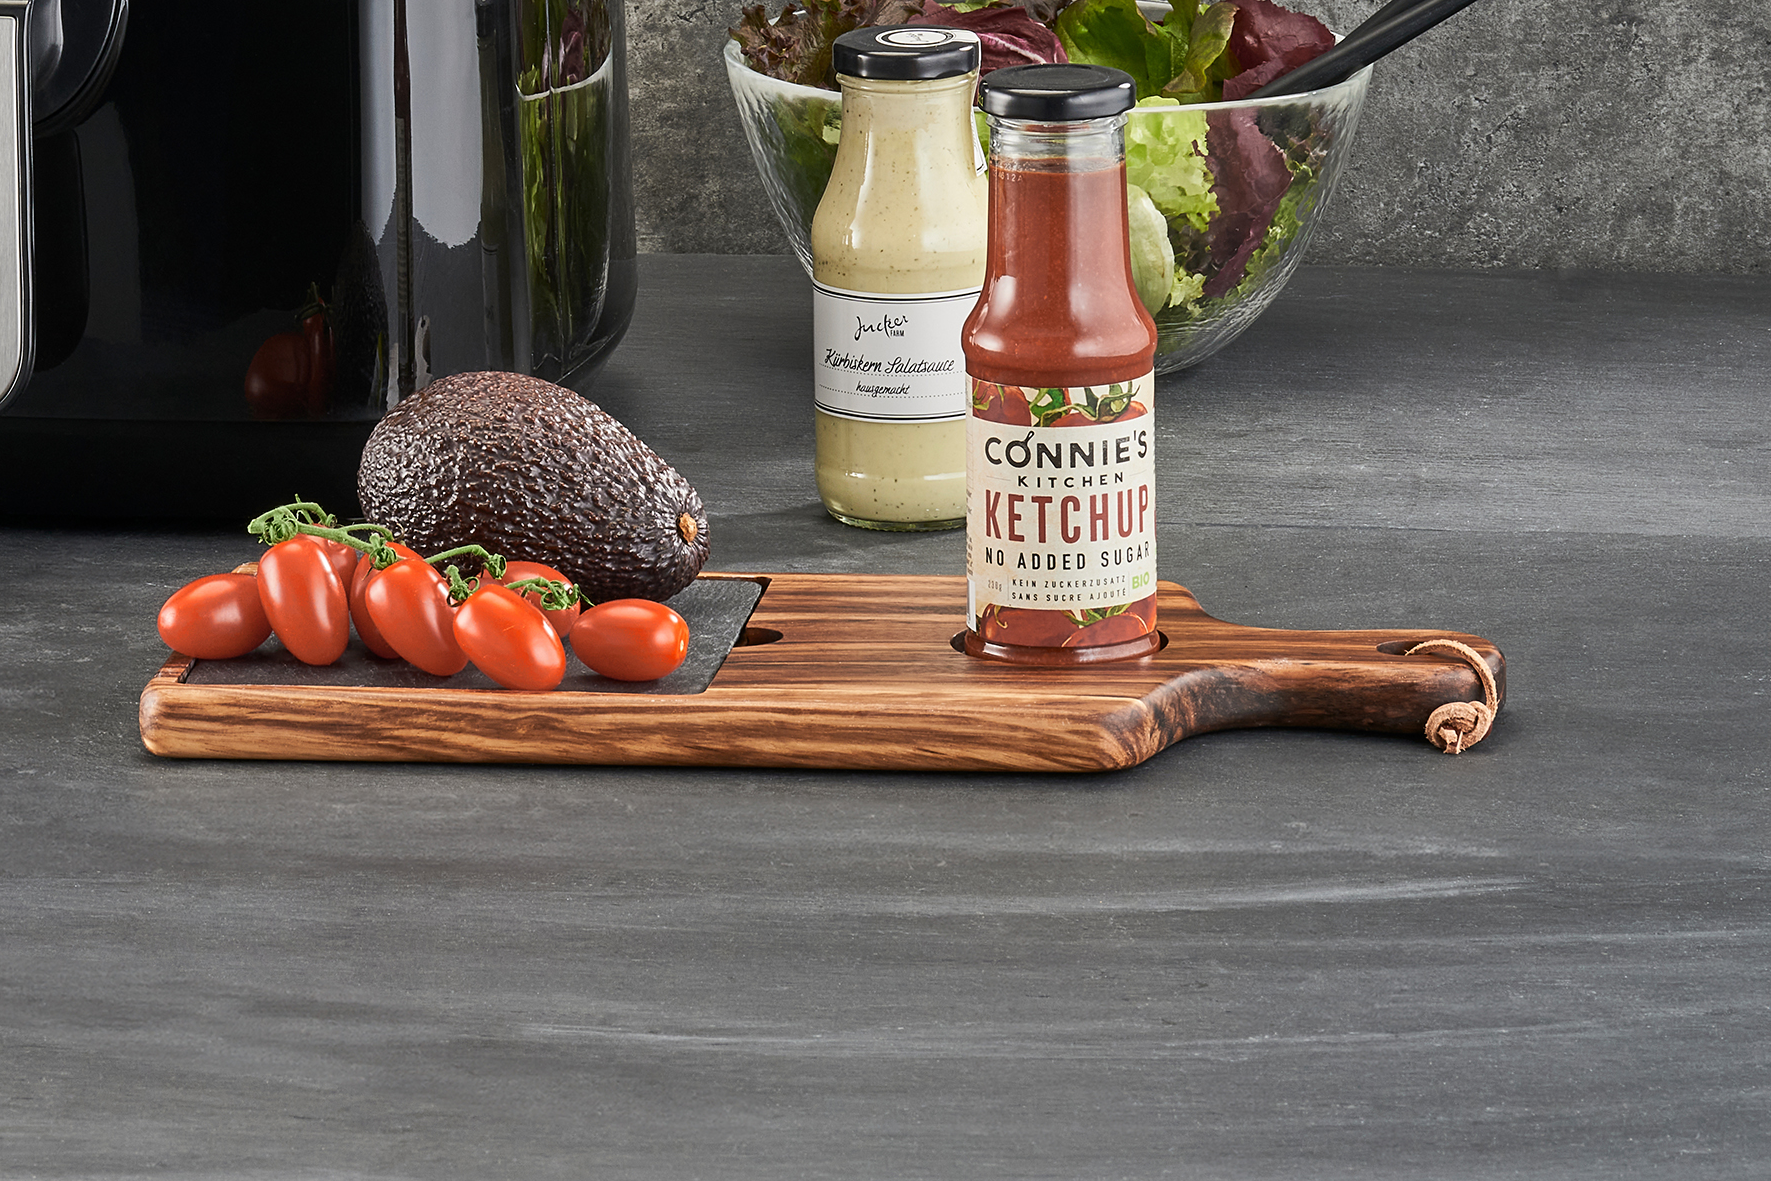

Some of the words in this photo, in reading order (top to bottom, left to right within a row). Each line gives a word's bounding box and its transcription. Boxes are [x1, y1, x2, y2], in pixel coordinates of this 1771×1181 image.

[854, 314, 909, 341] Jucker
[824, 348, 882, 372] Kürbiskern
[884, 356, 955, 374] Salatsauce
[856, 381, 910, 397] hausgemacht
[985, 430, 1148, 468] CONNIE'S
[1017, 472, 1124, 488] KITCHEN
[985, 484, 1149, 544] KETCHUP
[985, 546, 1004, 566] NO
[1017, 552, 1086, 570] ADDED
[1100, 541, 1150, 567] SUGAR
[1012, 578, 1037, 588] KEIN
[1044, 575, 1126, 589] ZUCKERZUSATZ
[1132, 571, 1150, 590] BIO
[1012, 591, 1038, 601] SANS
[1046, 593, 1081, 602] SUCRE
[1089, 588, 1127, 600] AJOUTÉ
